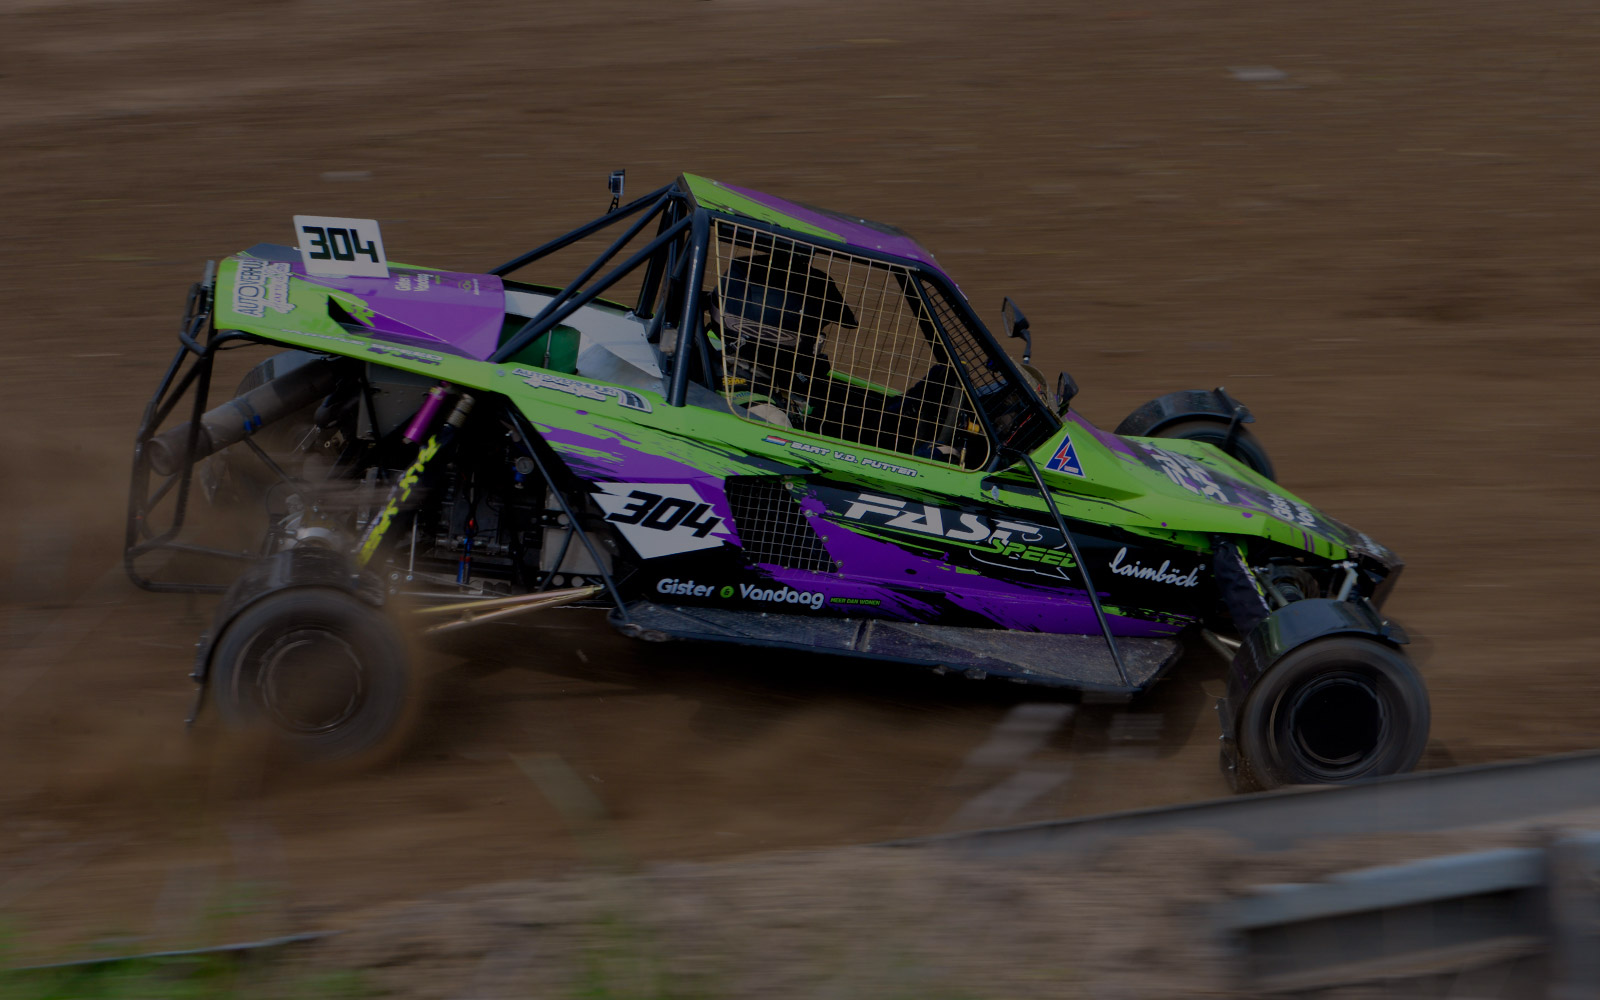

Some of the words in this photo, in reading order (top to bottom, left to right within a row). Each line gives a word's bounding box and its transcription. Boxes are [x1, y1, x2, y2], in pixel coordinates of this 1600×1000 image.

[302, 225, 380, 264] 304
[791, 441, 830, 456] BART
[605, 490, 722, 538] 304
[844, 493, 1040, 546] FAST
[656, 577, 716, 598] Gister
[739, 583, 825, 610] Vandaag
